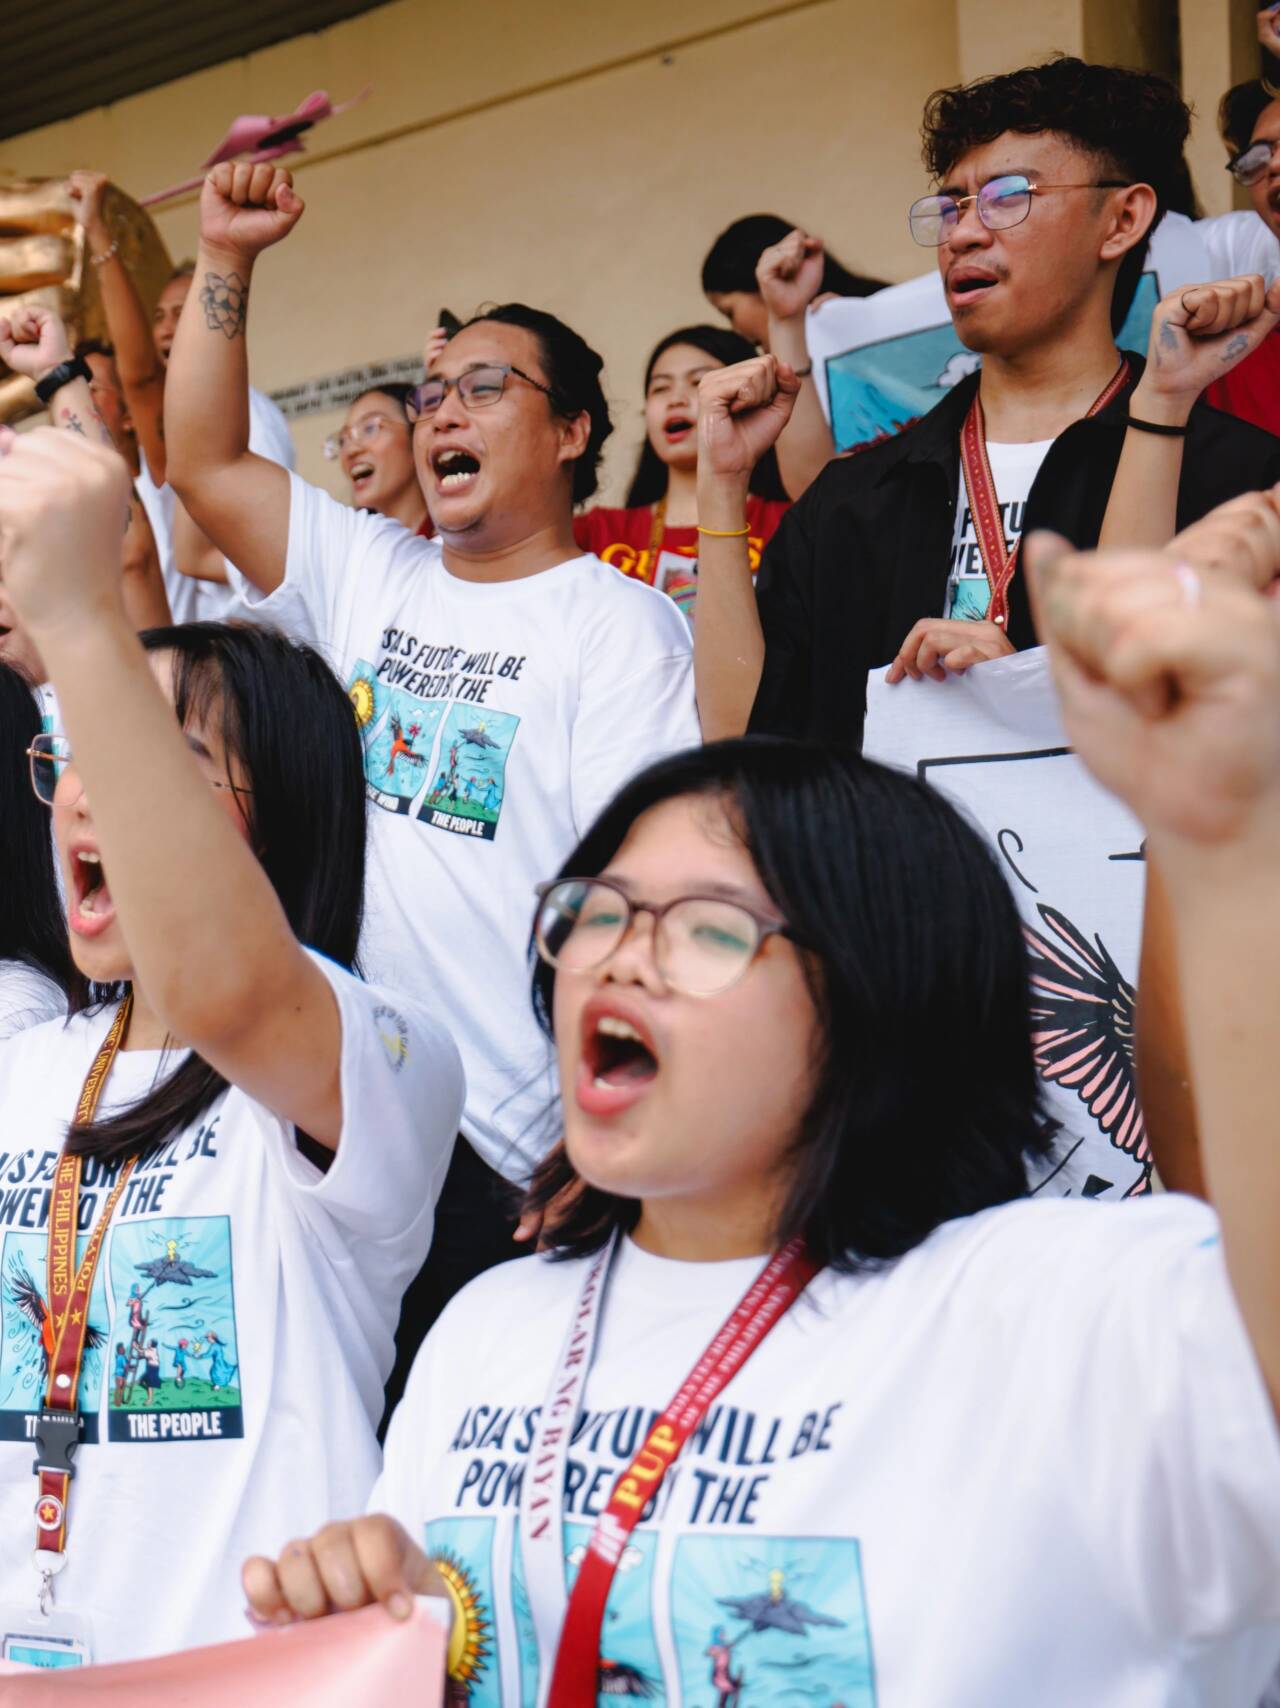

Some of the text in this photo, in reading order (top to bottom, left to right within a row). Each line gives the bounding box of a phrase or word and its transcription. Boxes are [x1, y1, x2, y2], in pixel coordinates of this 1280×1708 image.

[455, 676, 493, 703] THE
[498, 656, 526, 680] BE
[431, 810, 485, 836] THE PEOPLE
[120, 1174, 173, 1217] THE
[52, 1155, 76, 1295] THE PHILIPPINES
[548, 1373, 578, 1422] NG
[128, 1411, 222, 1438] THE PEOPLE
[789, 1402, 842, 1459] BE
[528, 1428, 562, 1543] BAYAN
[613, 1424, 678, 1510] PUP
[689, 1468, 770, 1524] THE
